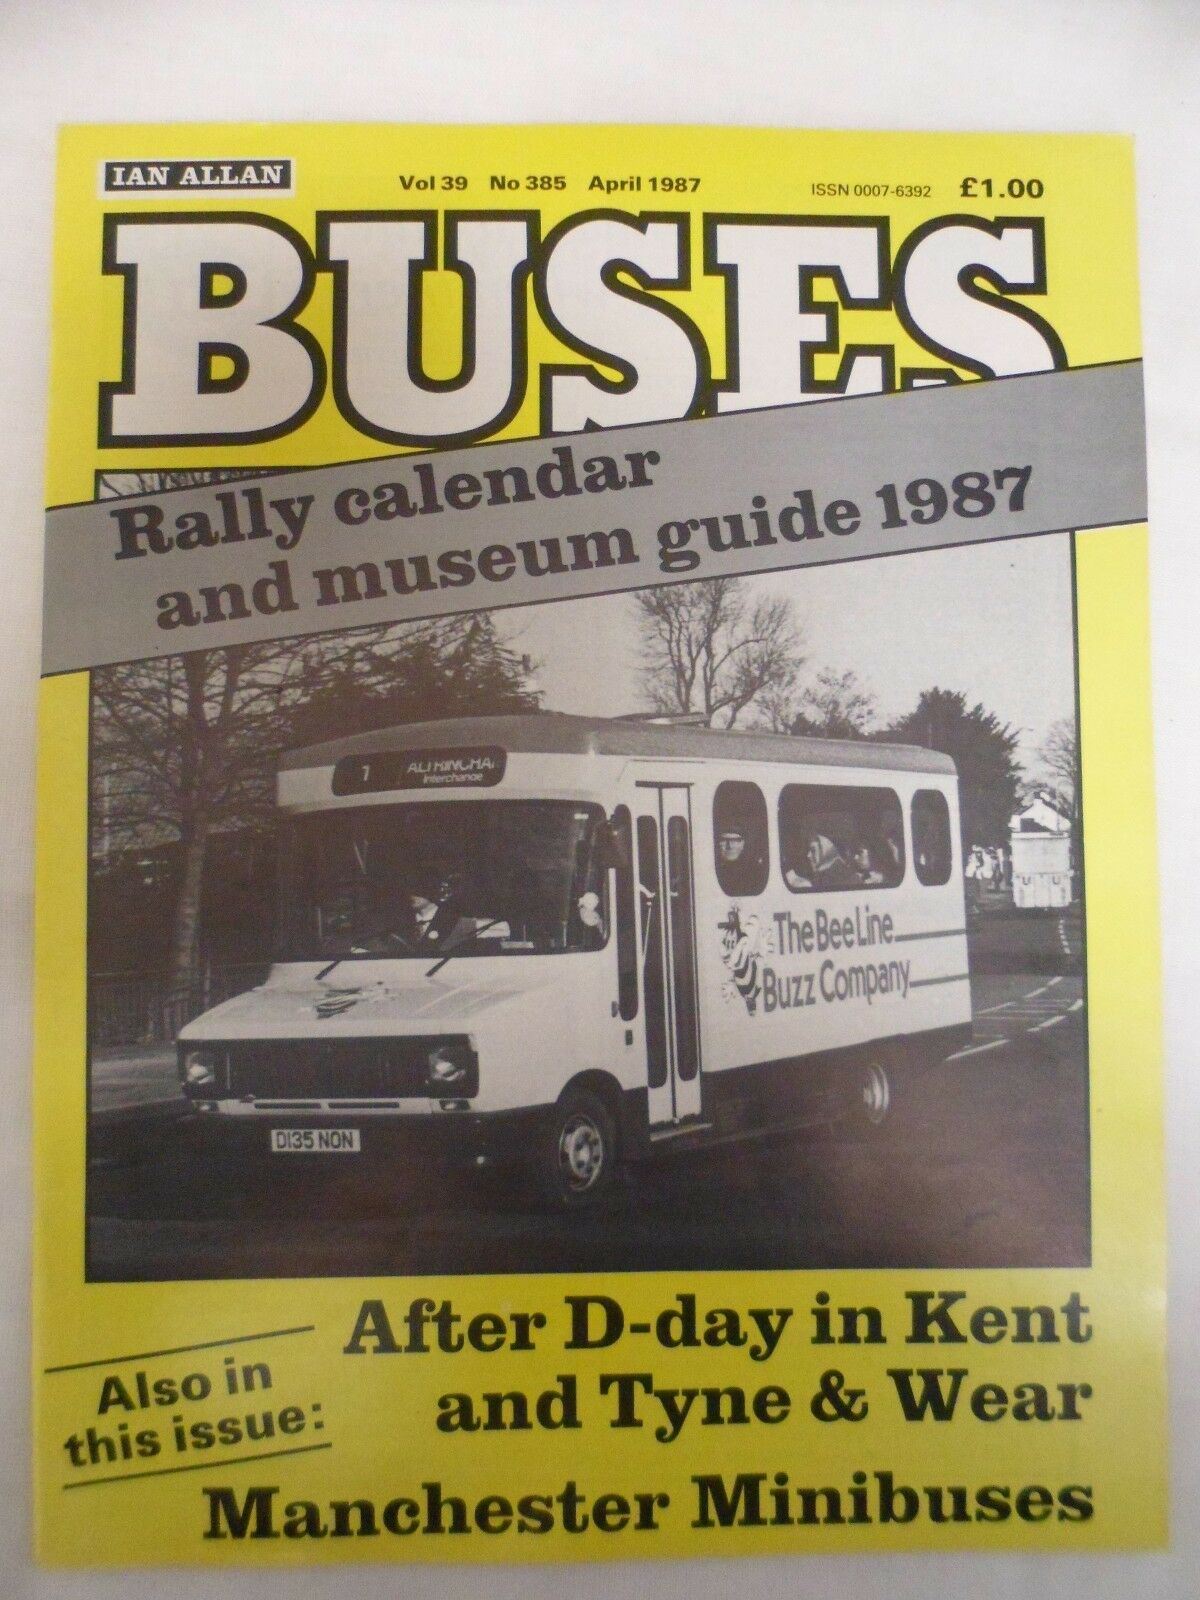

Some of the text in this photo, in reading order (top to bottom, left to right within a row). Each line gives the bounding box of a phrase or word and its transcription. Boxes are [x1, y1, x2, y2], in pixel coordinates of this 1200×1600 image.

[112, 165, 284, 186] IAN ALLAN
[399, 175, 701, 195] Vol 39 No 385 April 1987
[811, 182, 932, 198] ISSN 0007-6392
[959, 176, 1045, 199] £1.00
[98, 208, 1068, 449] BUSES
[110, 446, 660, 560] Rally calendar
[156, 465, 1032, 631] and museum guide 1987
[763, 959, 911, 1013] Buzz Company
[276, 1131, 354, 1149] D135 NON
[343, 1290, 1093, 1362] After D-day in Kent
[98, 1356, 272, 1415] Also in
[436, 1368, 1094, 1444] and Tyne & Wear
[63, 1402, 325, 1468] this issue:
[202, 1470, 1095, 1541] Manchester Minibuses
